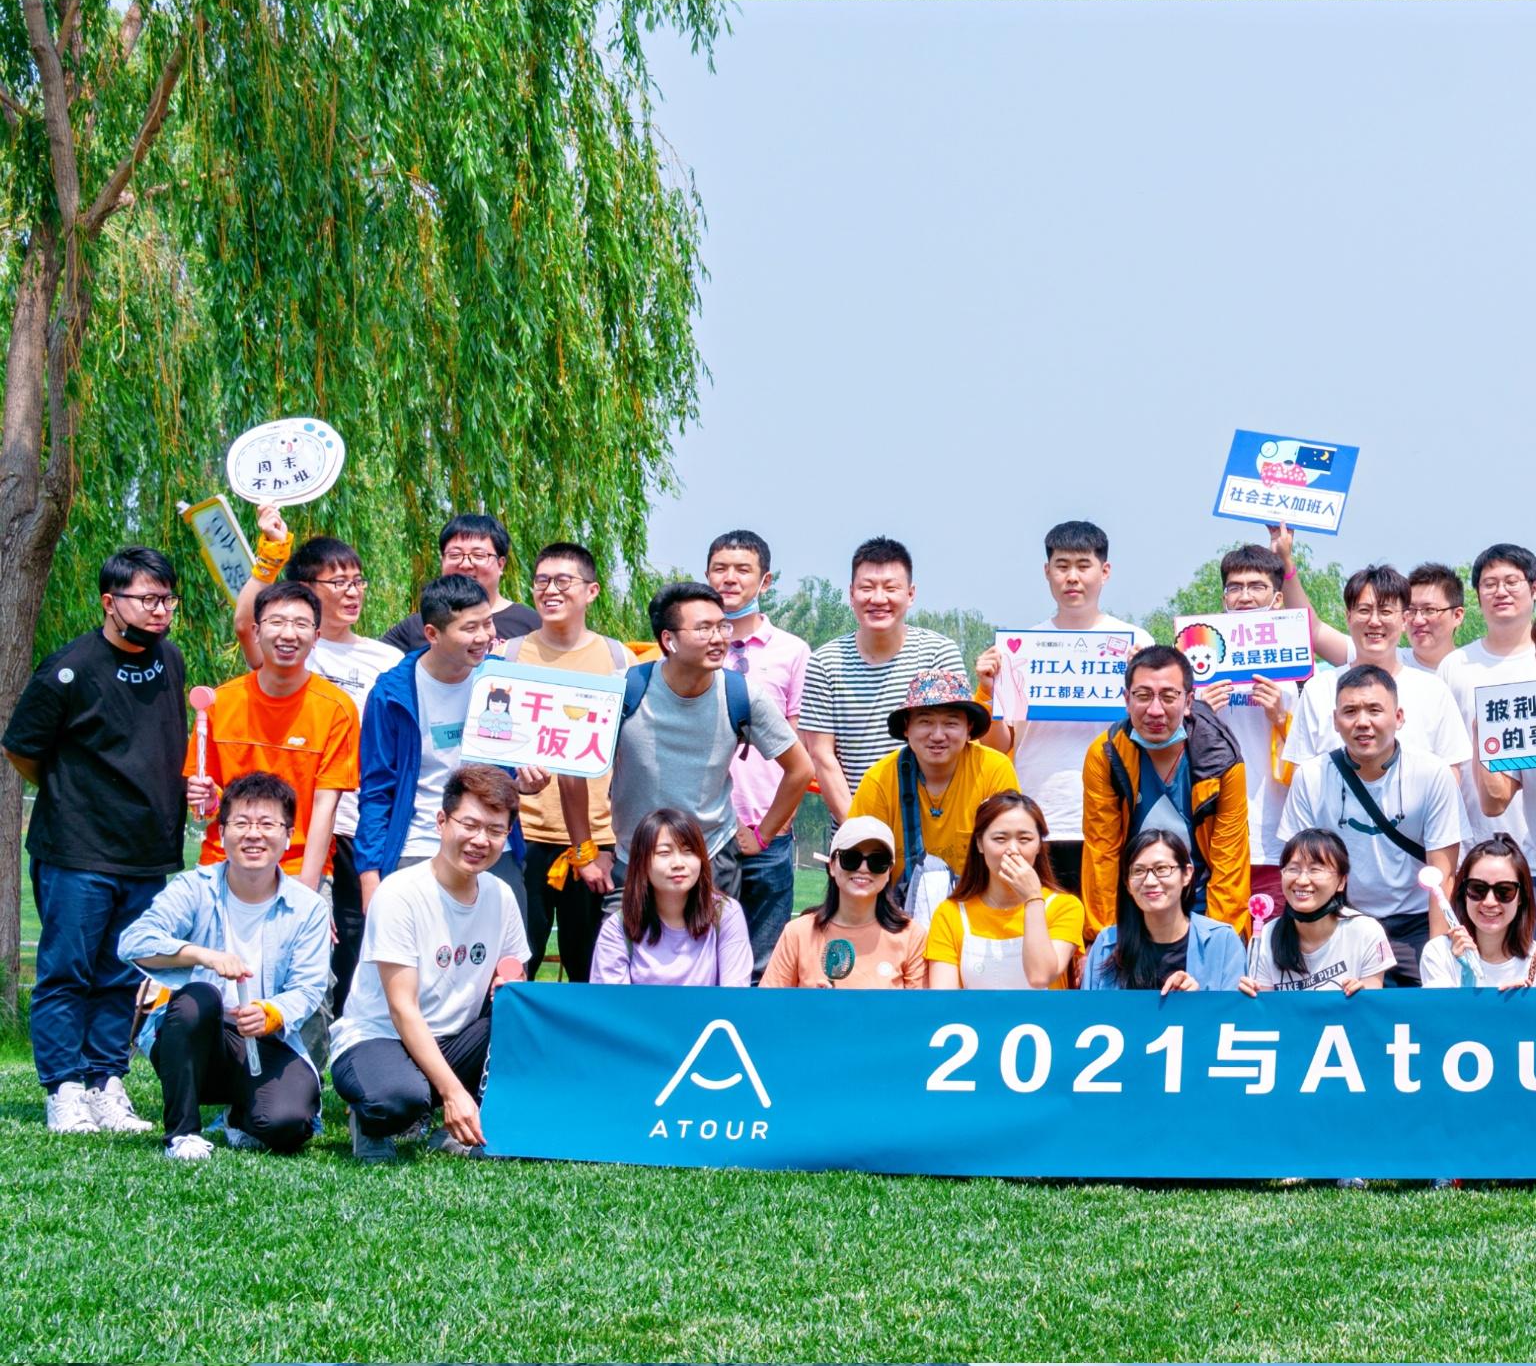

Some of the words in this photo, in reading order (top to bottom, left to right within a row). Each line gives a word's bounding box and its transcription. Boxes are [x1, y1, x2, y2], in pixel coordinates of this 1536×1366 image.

[258, 456, 297, 475] 周末
[252, 469, 310, 491] 不加班
[1230, 486, 1336, 516] 社会主义加班人
[1230, 622, 1278, 647] 小丑
[1030, 659, 1076, 674] 打工人
[1081, 660, 1127, 675] 打工魂
[1231, 647, 1309, 666] 竟是我自己
[116, 660, 164, 684] CODE
[1030, 685, 1126, 699] 打工都是人上人
[521, 691, 554, 722] 干
[536, 725, 607, 764] 饭人
[1276, 981, 1299, 991] TAKE
[1302, 977, 1316, 989] THE
[1319, 963, 1344, 982] PIZZA
[649, 1119, 770, 1141] ATOUR
